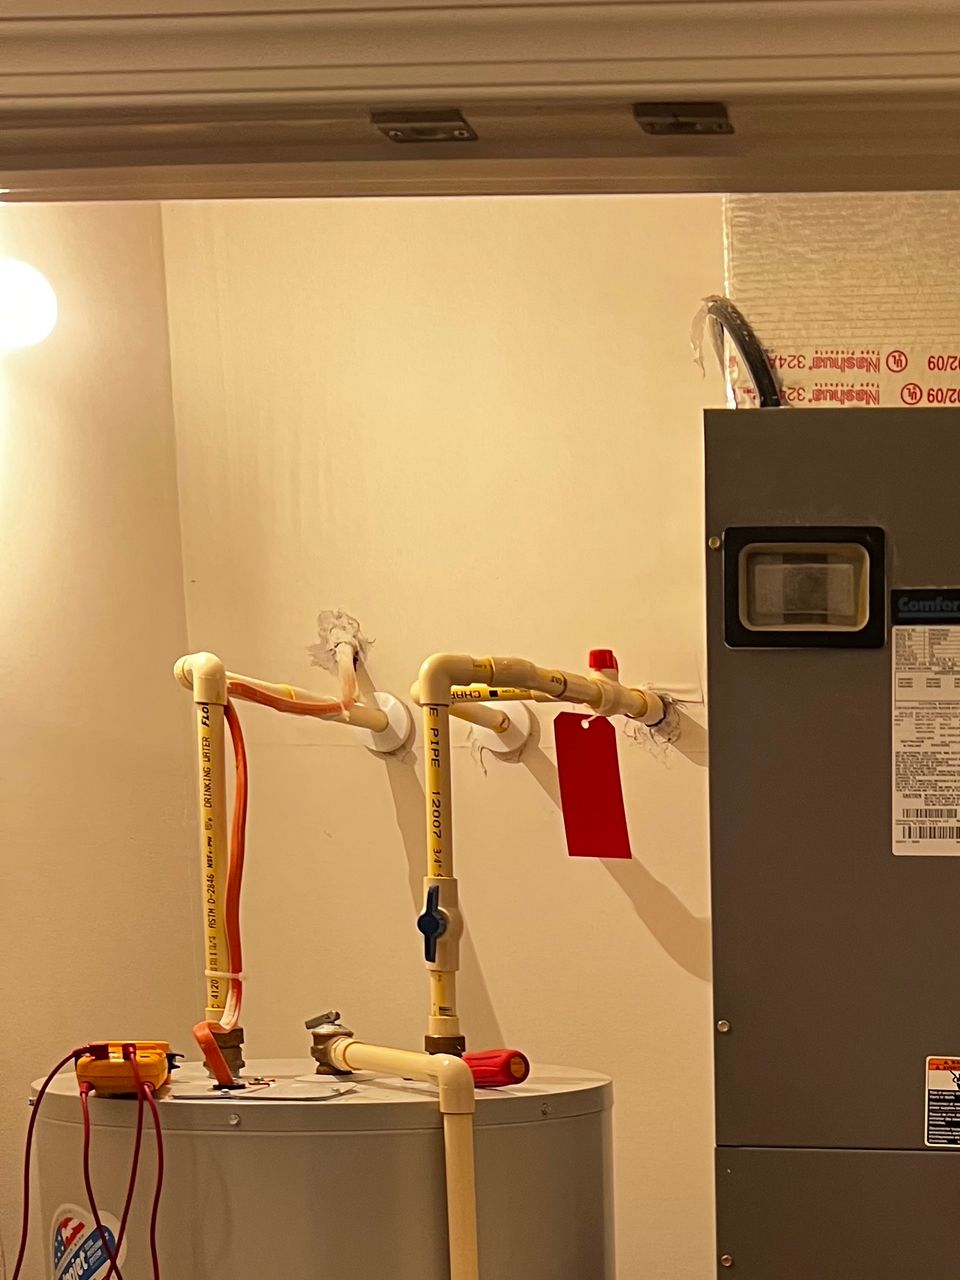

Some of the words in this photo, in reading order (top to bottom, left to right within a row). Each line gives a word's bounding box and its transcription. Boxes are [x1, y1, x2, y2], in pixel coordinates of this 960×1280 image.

[811, 356, 881, 374] Nashua
[779, 386, 806, 402] 324
[811, 388, 880, 406] Nashua
[201, 702, 210, 728] FLO
[202, 736, 211, 763] WATER
[430, 727, 440, 768] PIPE
[202, 767, 213, 809] DRINKING
[206, 873, 216, 905] D-2846
[208, 906, 217, 929] ASTM
[210, 979, 220, 1000] 4120
